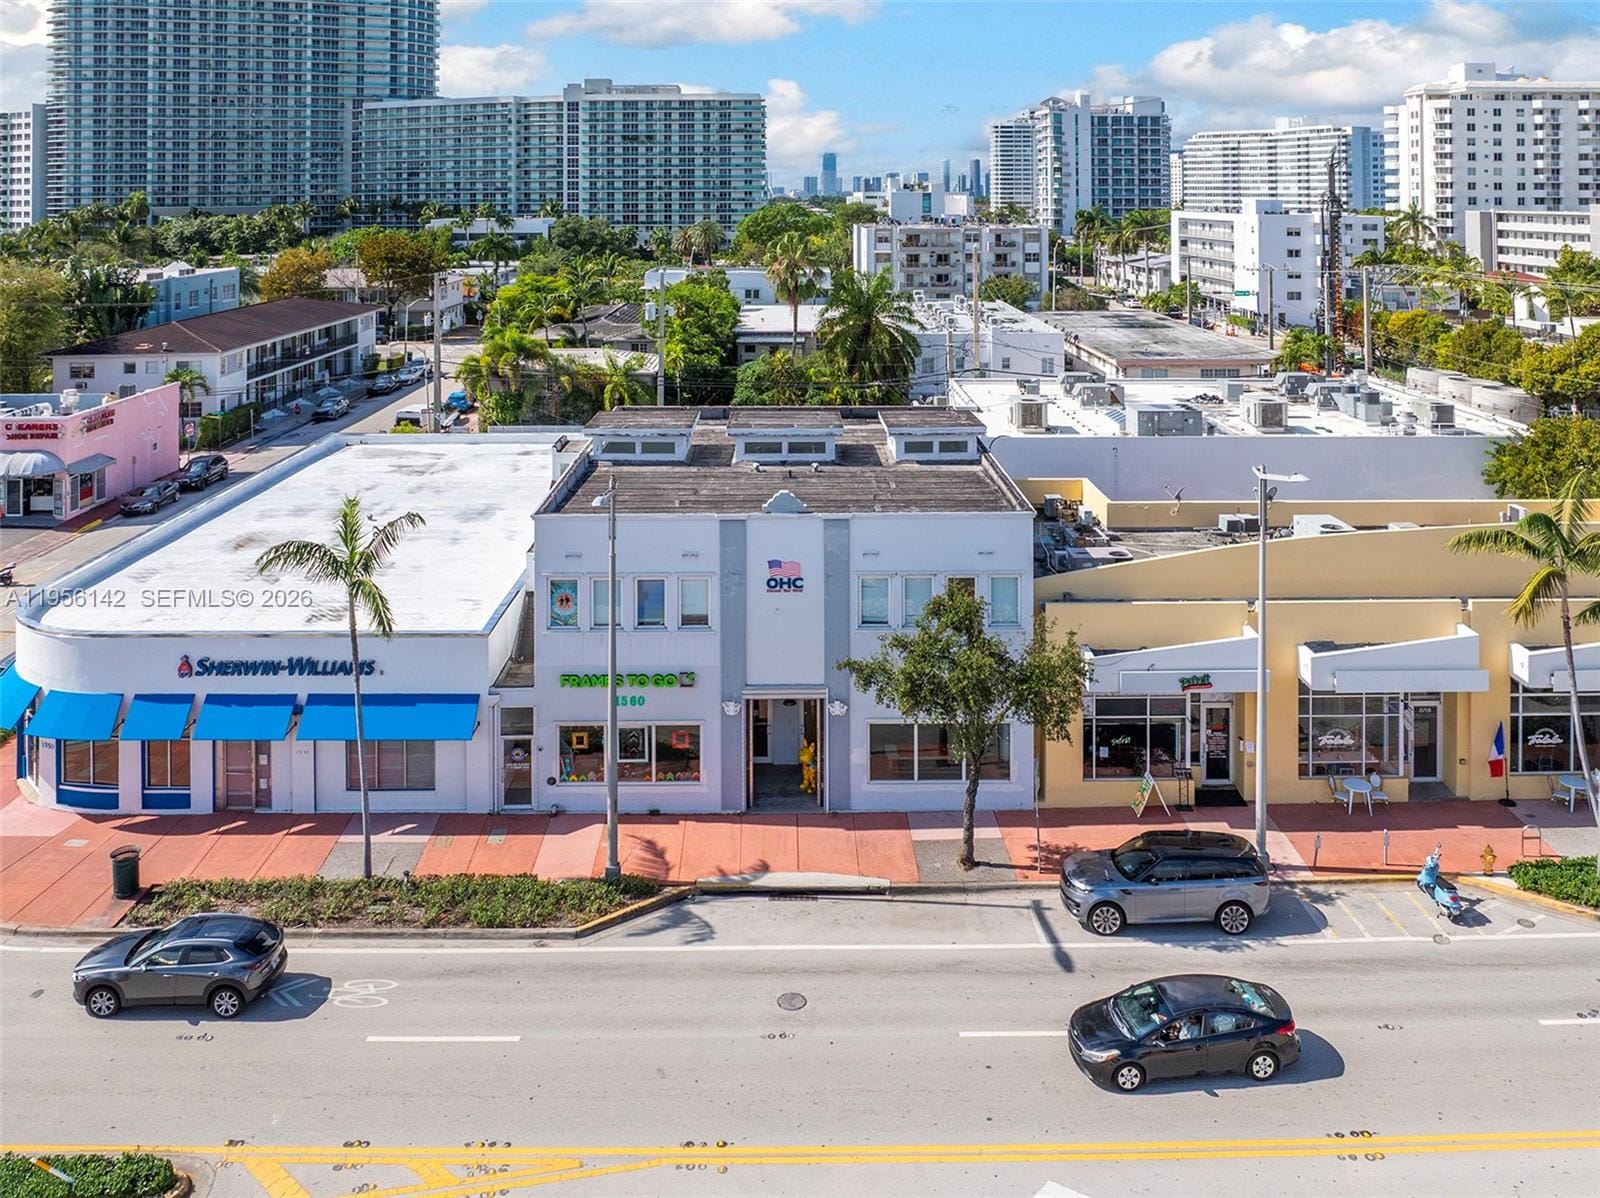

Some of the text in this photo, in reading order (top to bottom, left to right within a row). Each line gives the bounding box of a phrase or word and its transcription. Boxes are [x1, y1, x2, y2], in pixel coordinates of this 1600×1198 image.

[5, 423, 59, 431] CEANERS
[30, 432, 59, 440] REPAIR
[766, 577, 804, 589] OHC
[626, 673, 649, 689] TO
[651, 673, 678, 689] GO
[616, 695, 646, 707] 1560
